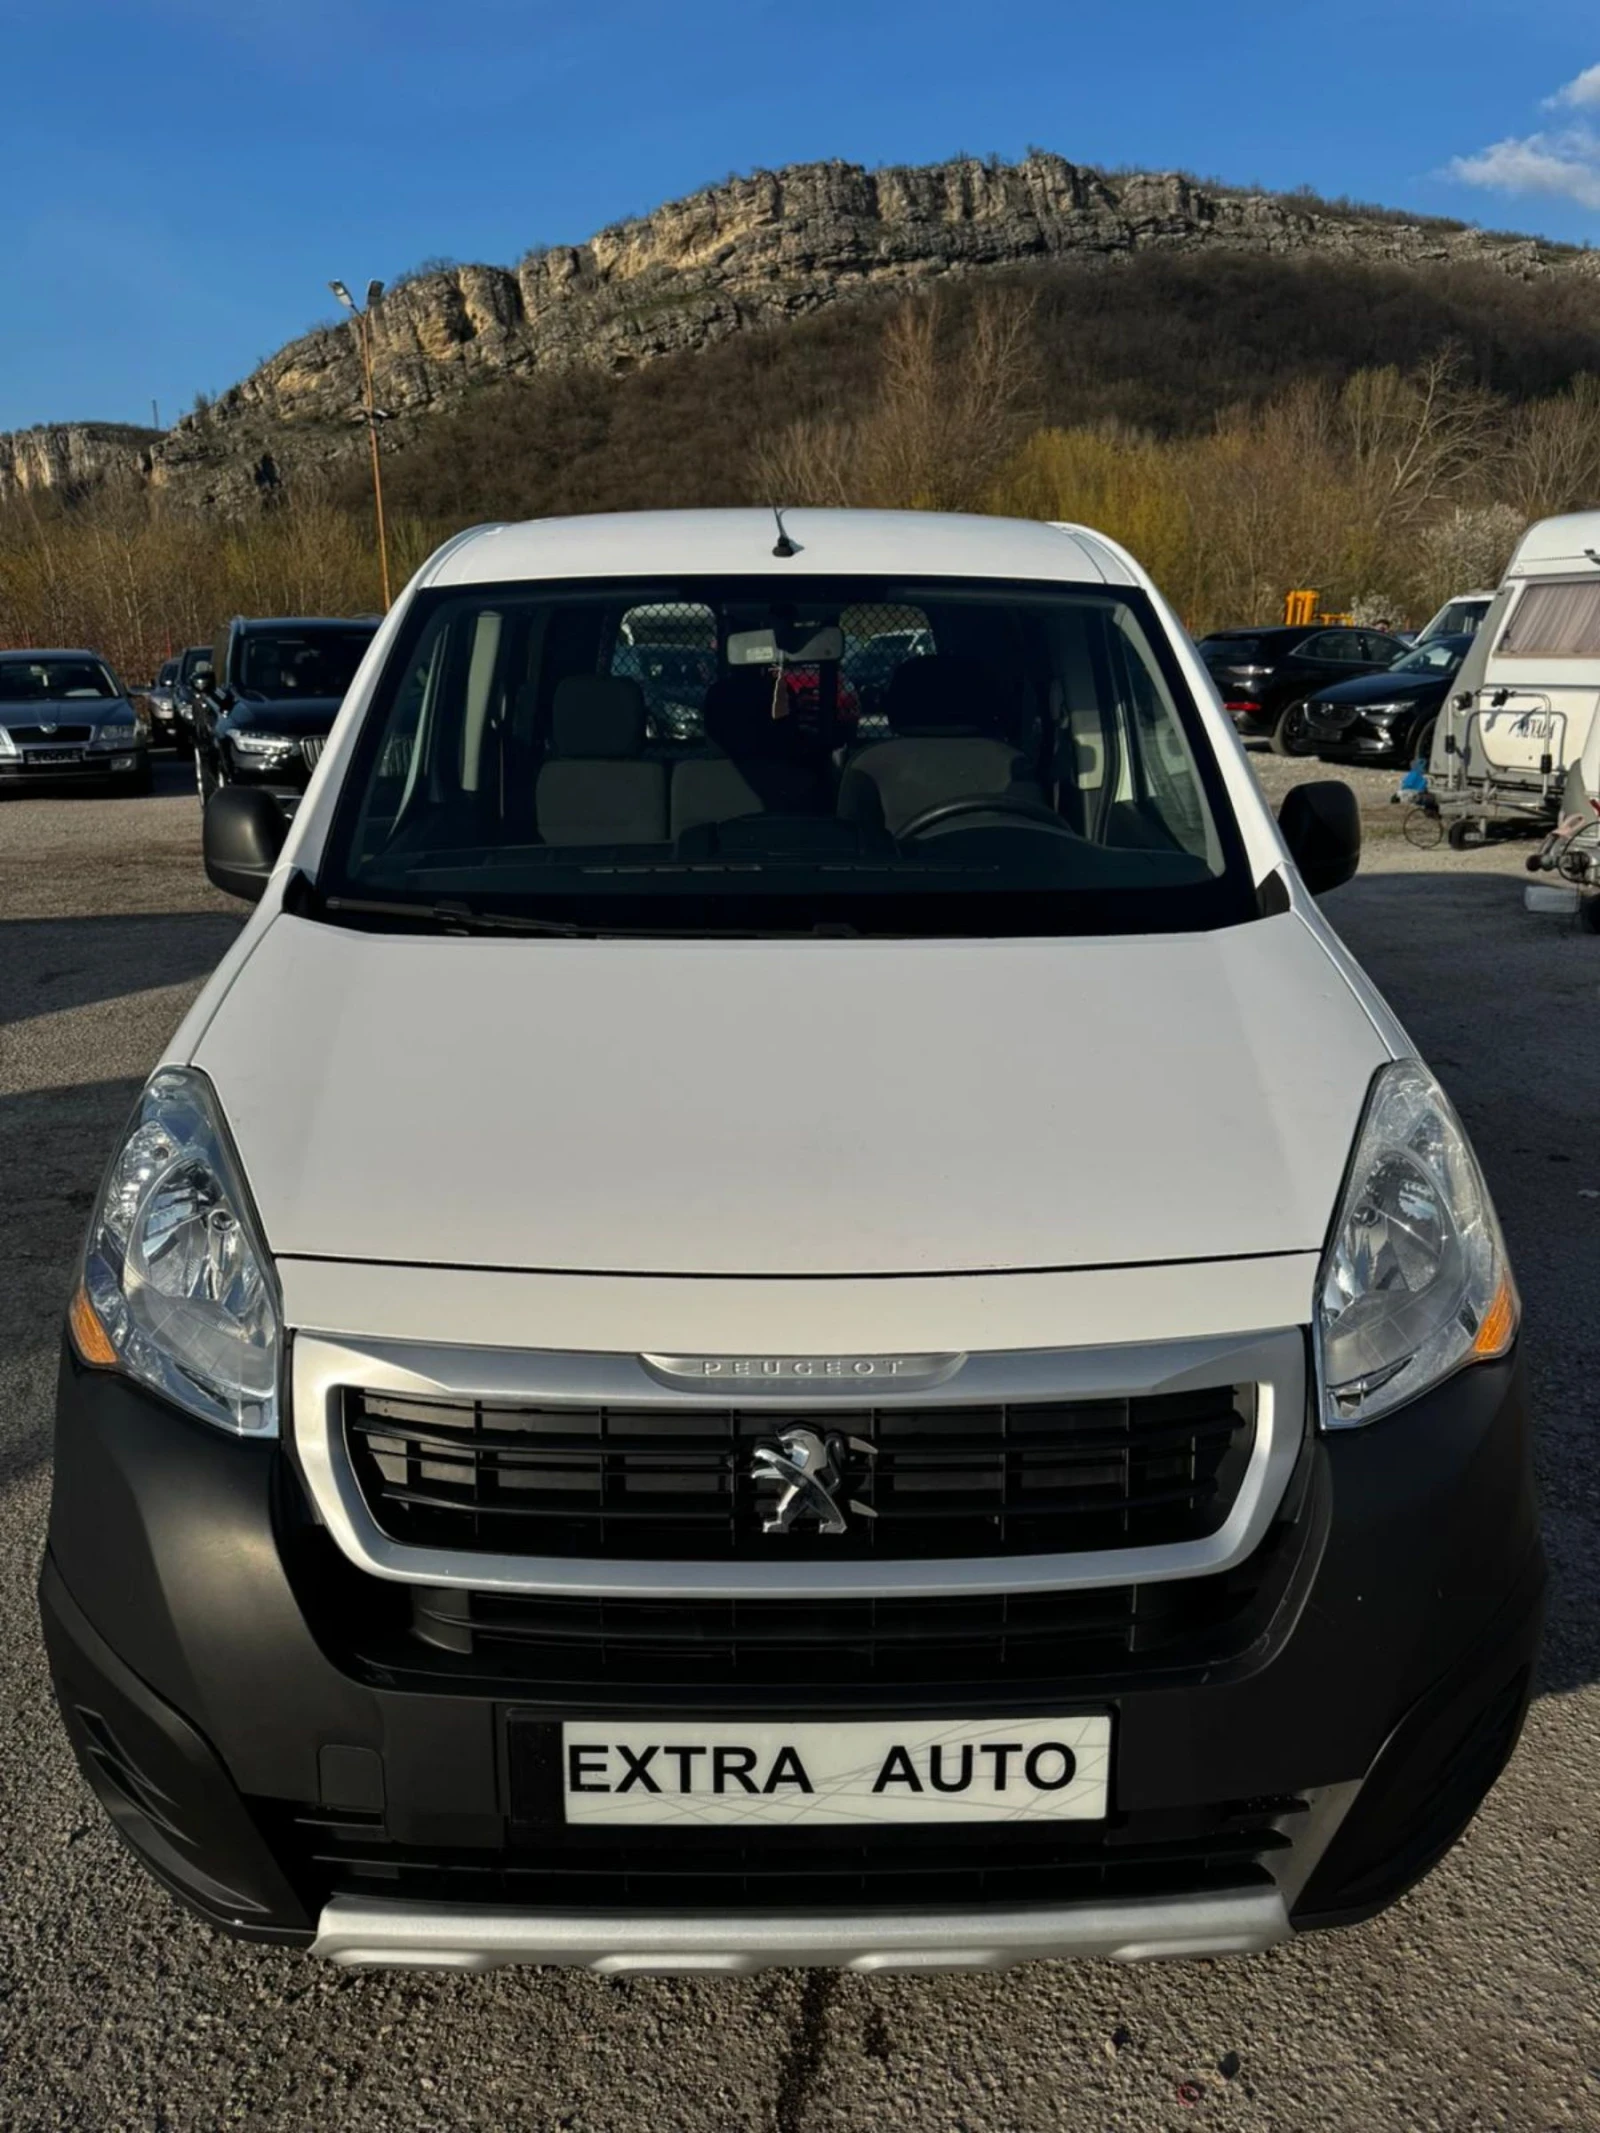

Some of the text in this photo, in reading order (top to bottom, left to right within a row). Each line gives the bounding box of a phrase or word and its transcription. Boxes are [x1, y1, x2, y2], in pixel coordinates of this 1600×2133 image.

[702, 1359, 903, 1375] PEUGEOT
[568, 1742, 1077, 1794] EXTRA AUTO
